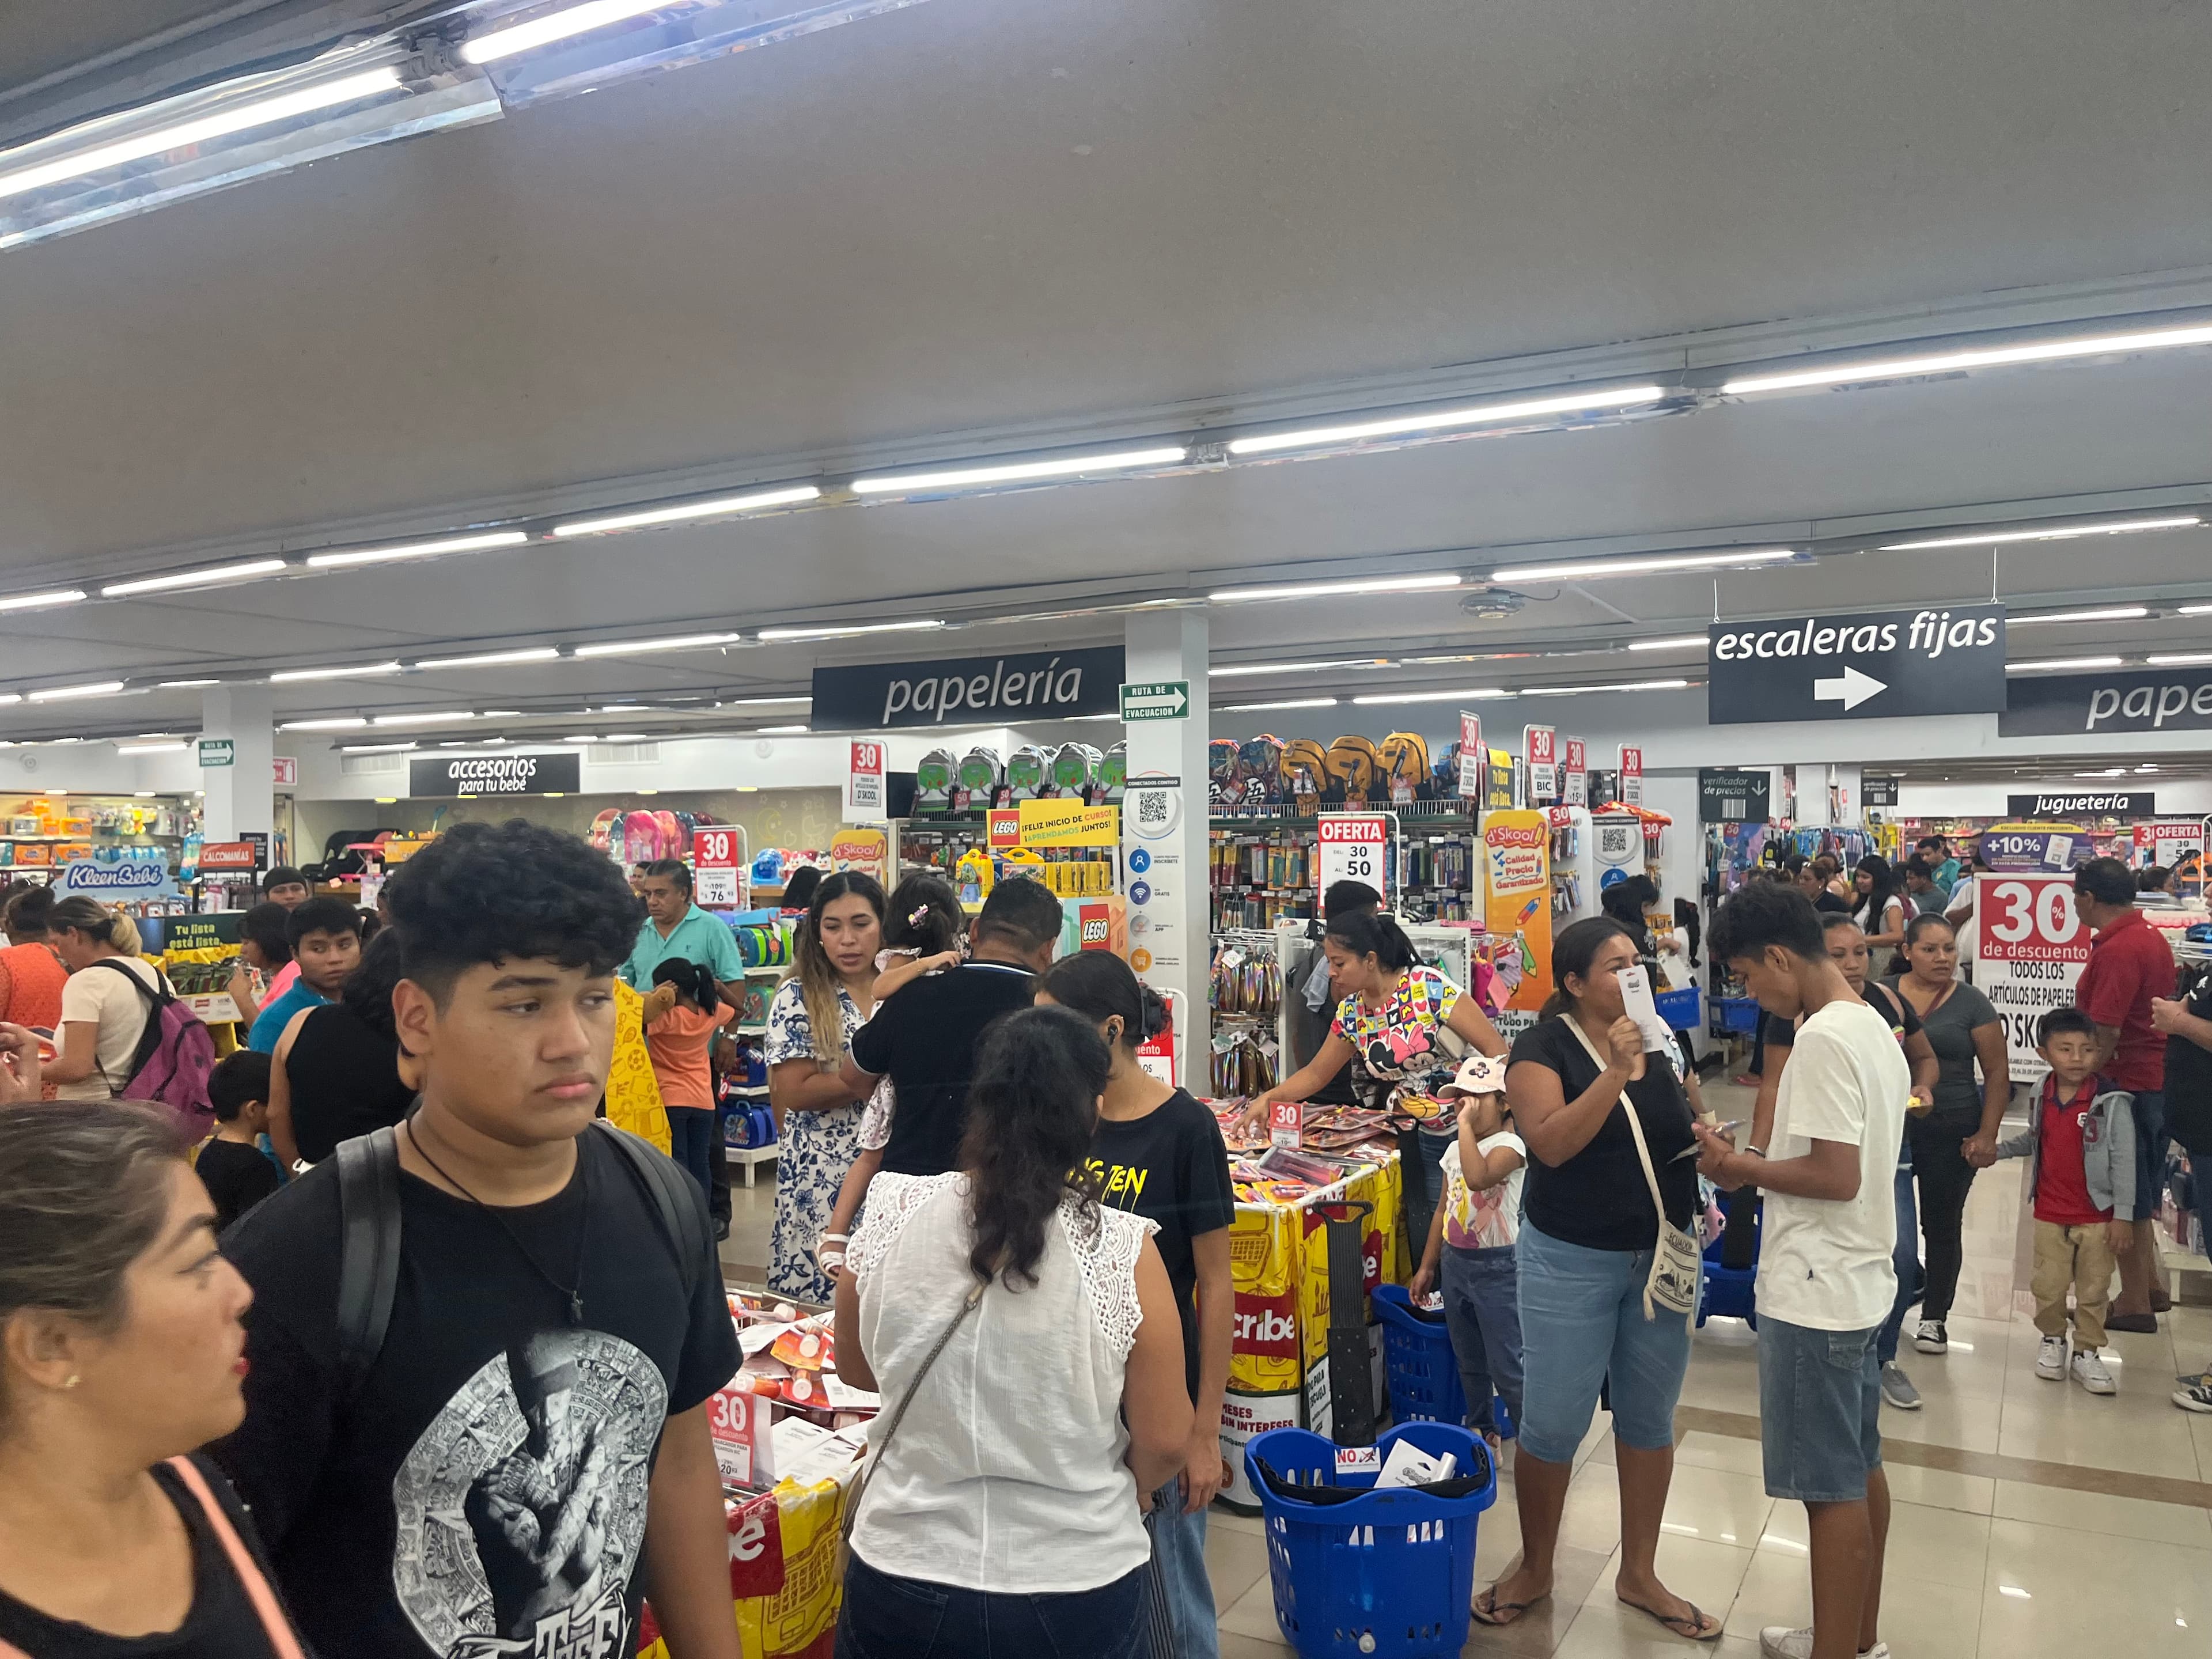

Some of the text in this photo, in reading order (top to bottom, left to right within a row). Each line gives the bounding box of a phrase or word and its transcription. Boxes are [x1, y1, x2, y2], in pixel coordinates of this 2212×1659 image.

[1715, 611, 1997, 660] escaleras fijas
[882, 657, 1082, 725] papelería
[1132, 685, 1165, 696] RUTA DE
[1126, 707, 1173, 718] EVACUACION
[449, 755, 537, 778] accesorios
[459, 776, 527, 794] para tu bebé
[1537, 782, 1551, 791] BIC
[1703, 777, 1748, 785] verificador
[1705, 786, 1746, 796] de precios
[2033, 794, 2129, 815] juguetería
[1022, 822, 1044, 832] ¡FELIZ
[1046, 817, 1070, 827] INICIO
[1084, 809, 1112, 821] CURSO!
[1081, 820, 1111, 833] JUNTOS!
[993, 821, 1018, 835] LEGO
[1321, 822, 1382, 840] OFERTA
[2156, 826, 2200, 838] OFERTA
[1487, 828, 1535, 843] d'Skool
[834, 844, 876, 857] d'Skool
[1350, 846, 1367, 857] 30
[1988, 836, 2041, 854] +10%
[203, 848, 249, 862] CALCOMANÍAS
[1506, 853, 1535, 864] Calidad
[70, 865, 161, 886] KleenBebé
[1347, 861, 1371, 876] 50
[1506, 865, 1533, 876] Precio
[1496, 877, 1543, 889] Garantizado
[710, 891, 724, 901] 76
[175, 923, 215, 936] Tu lista
[1083, 921, 1108, 941] LEGO
[169, 936, 223, 949] está lista.
[1983, 941, 2088, 959] de descuento
[2009, 961, 2064, 980] TODOS LOS
[1988, 980, 2077, 1008] ARTÍCULOS DE PAPELER
[1143, 1064, 1152, 1073] OS
[1106, 1165, 1148, 1197] TEN
[1670, 1233, 1693, 1251] ECUADOR
[1338, 1449, 1357, 1463] NO
